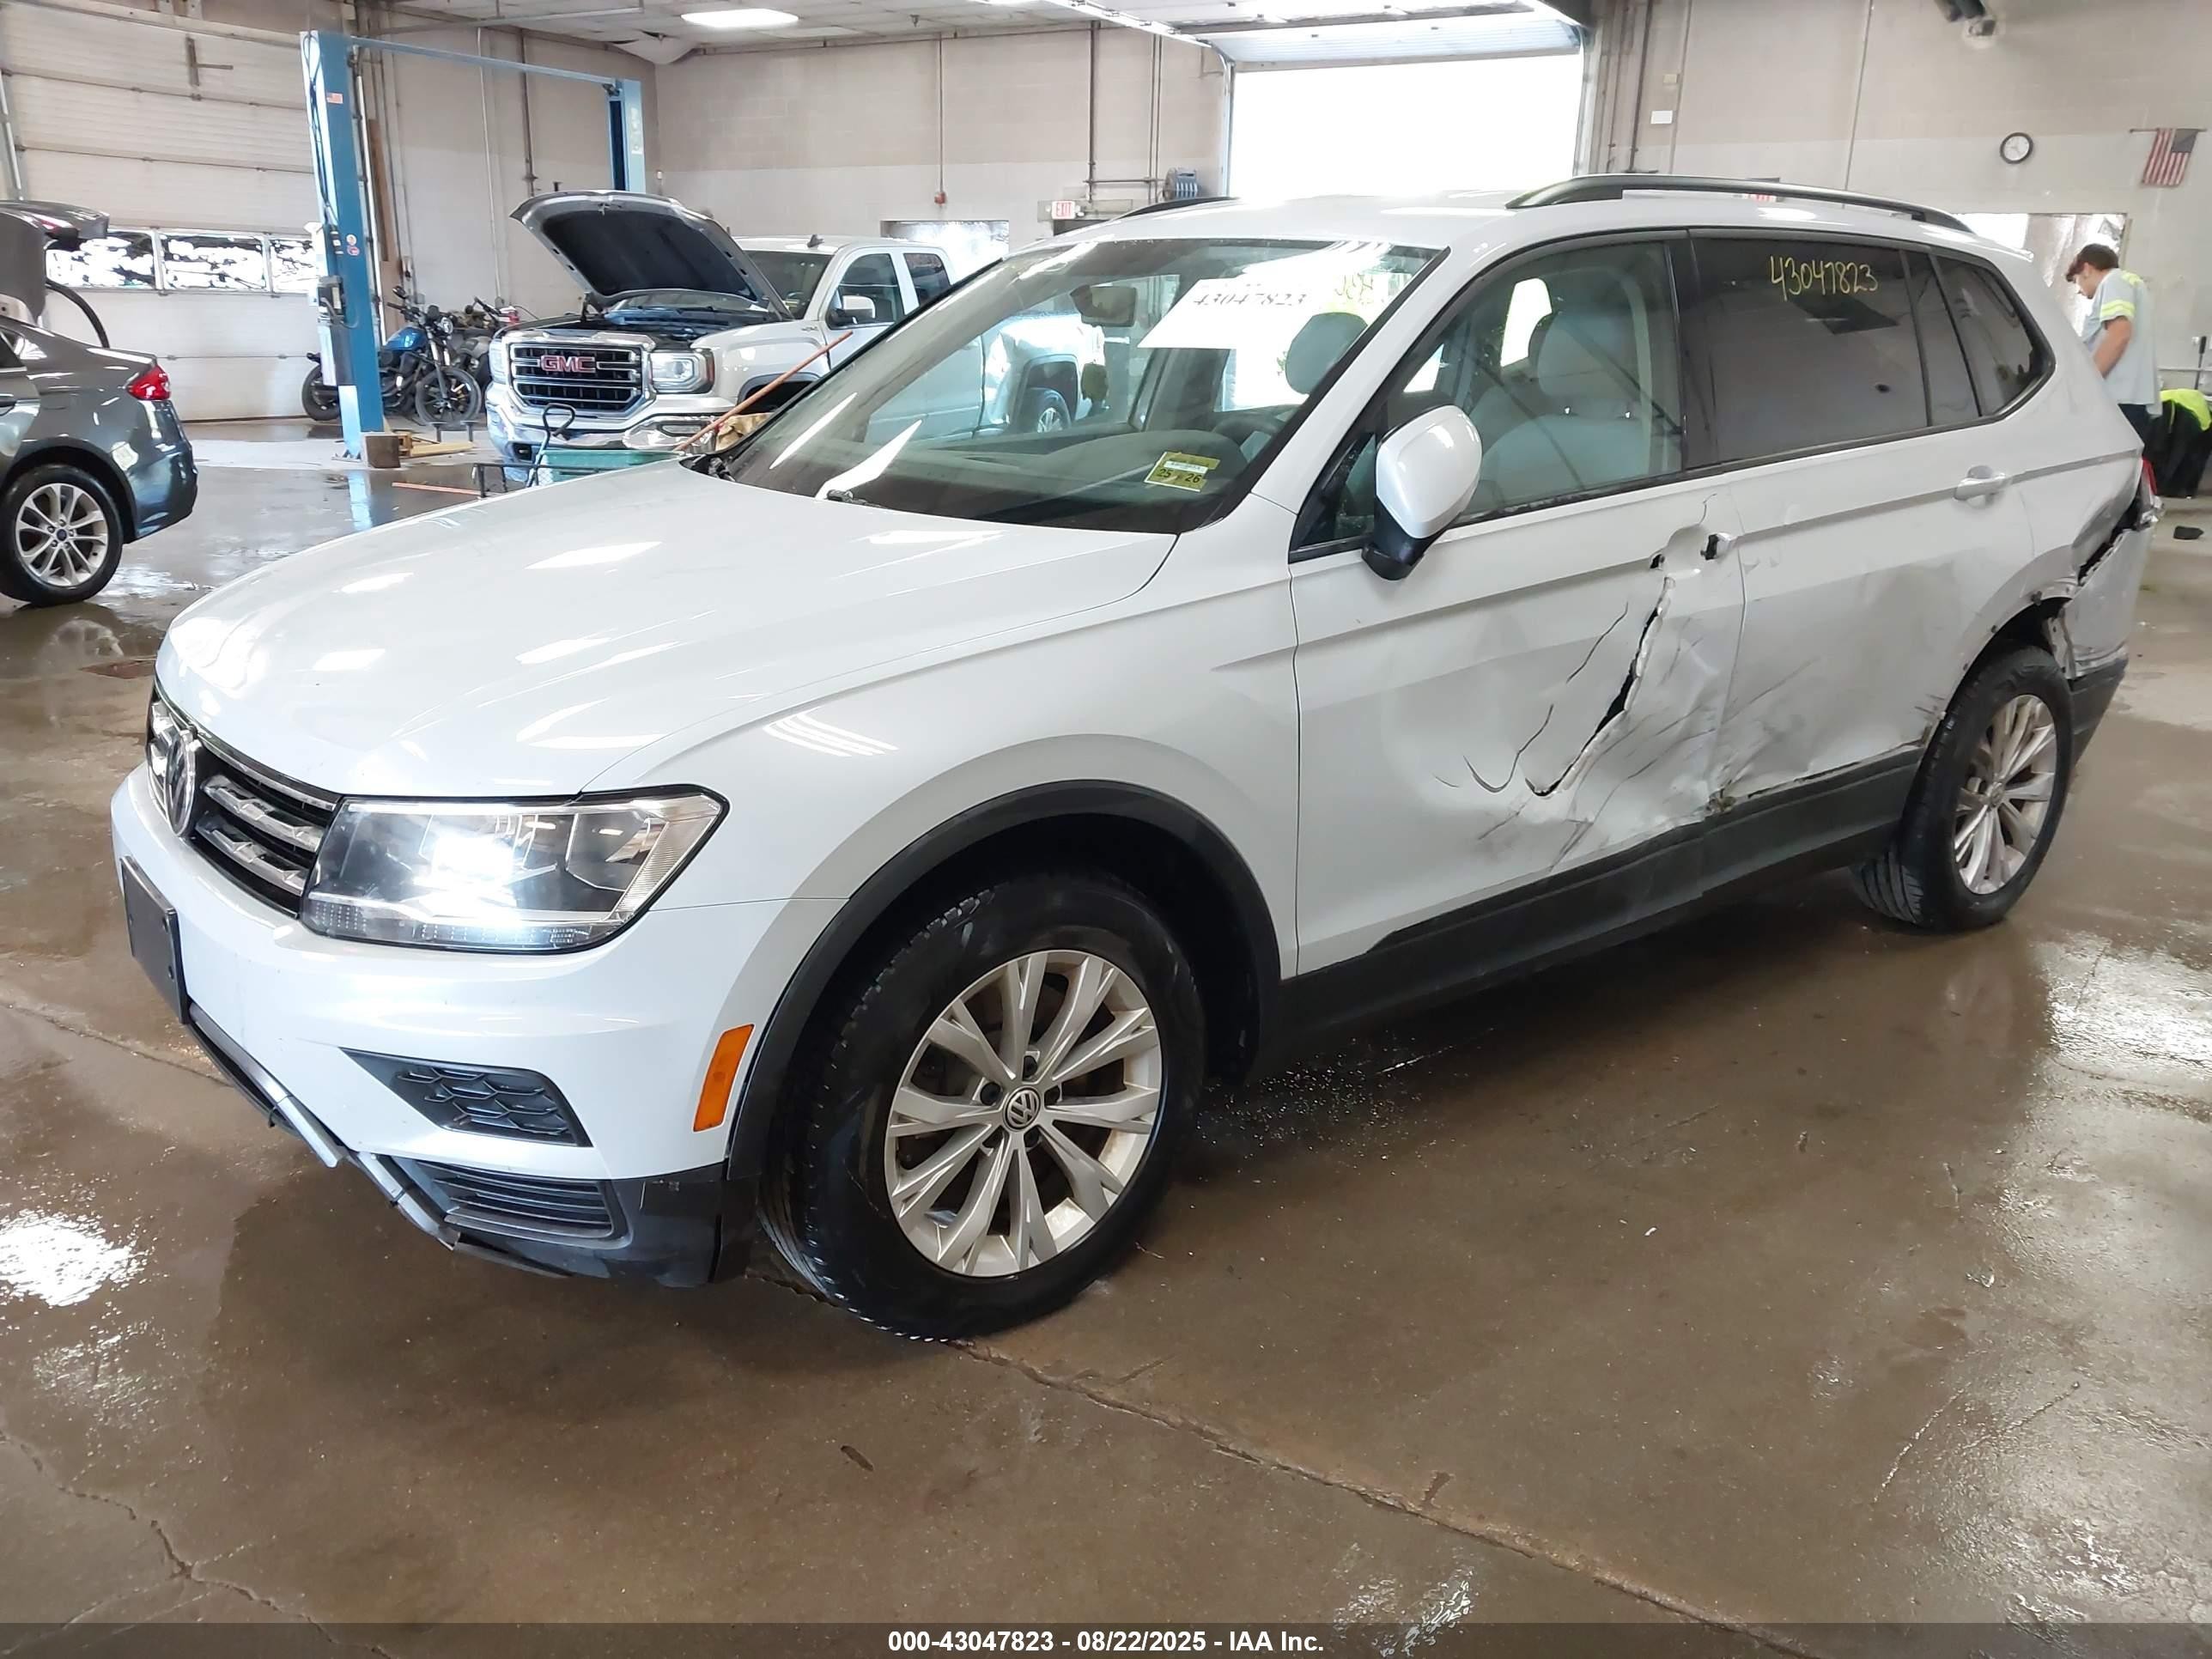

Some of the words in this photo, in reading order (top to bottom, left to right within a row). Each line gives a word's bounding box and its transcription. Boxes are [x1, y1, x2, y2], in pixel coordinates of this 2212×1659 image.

[1770, 255, 1879, 301] 43047823
[540, 355, 596, 373] GMC
[1185, 473, 1202, 483] 26
